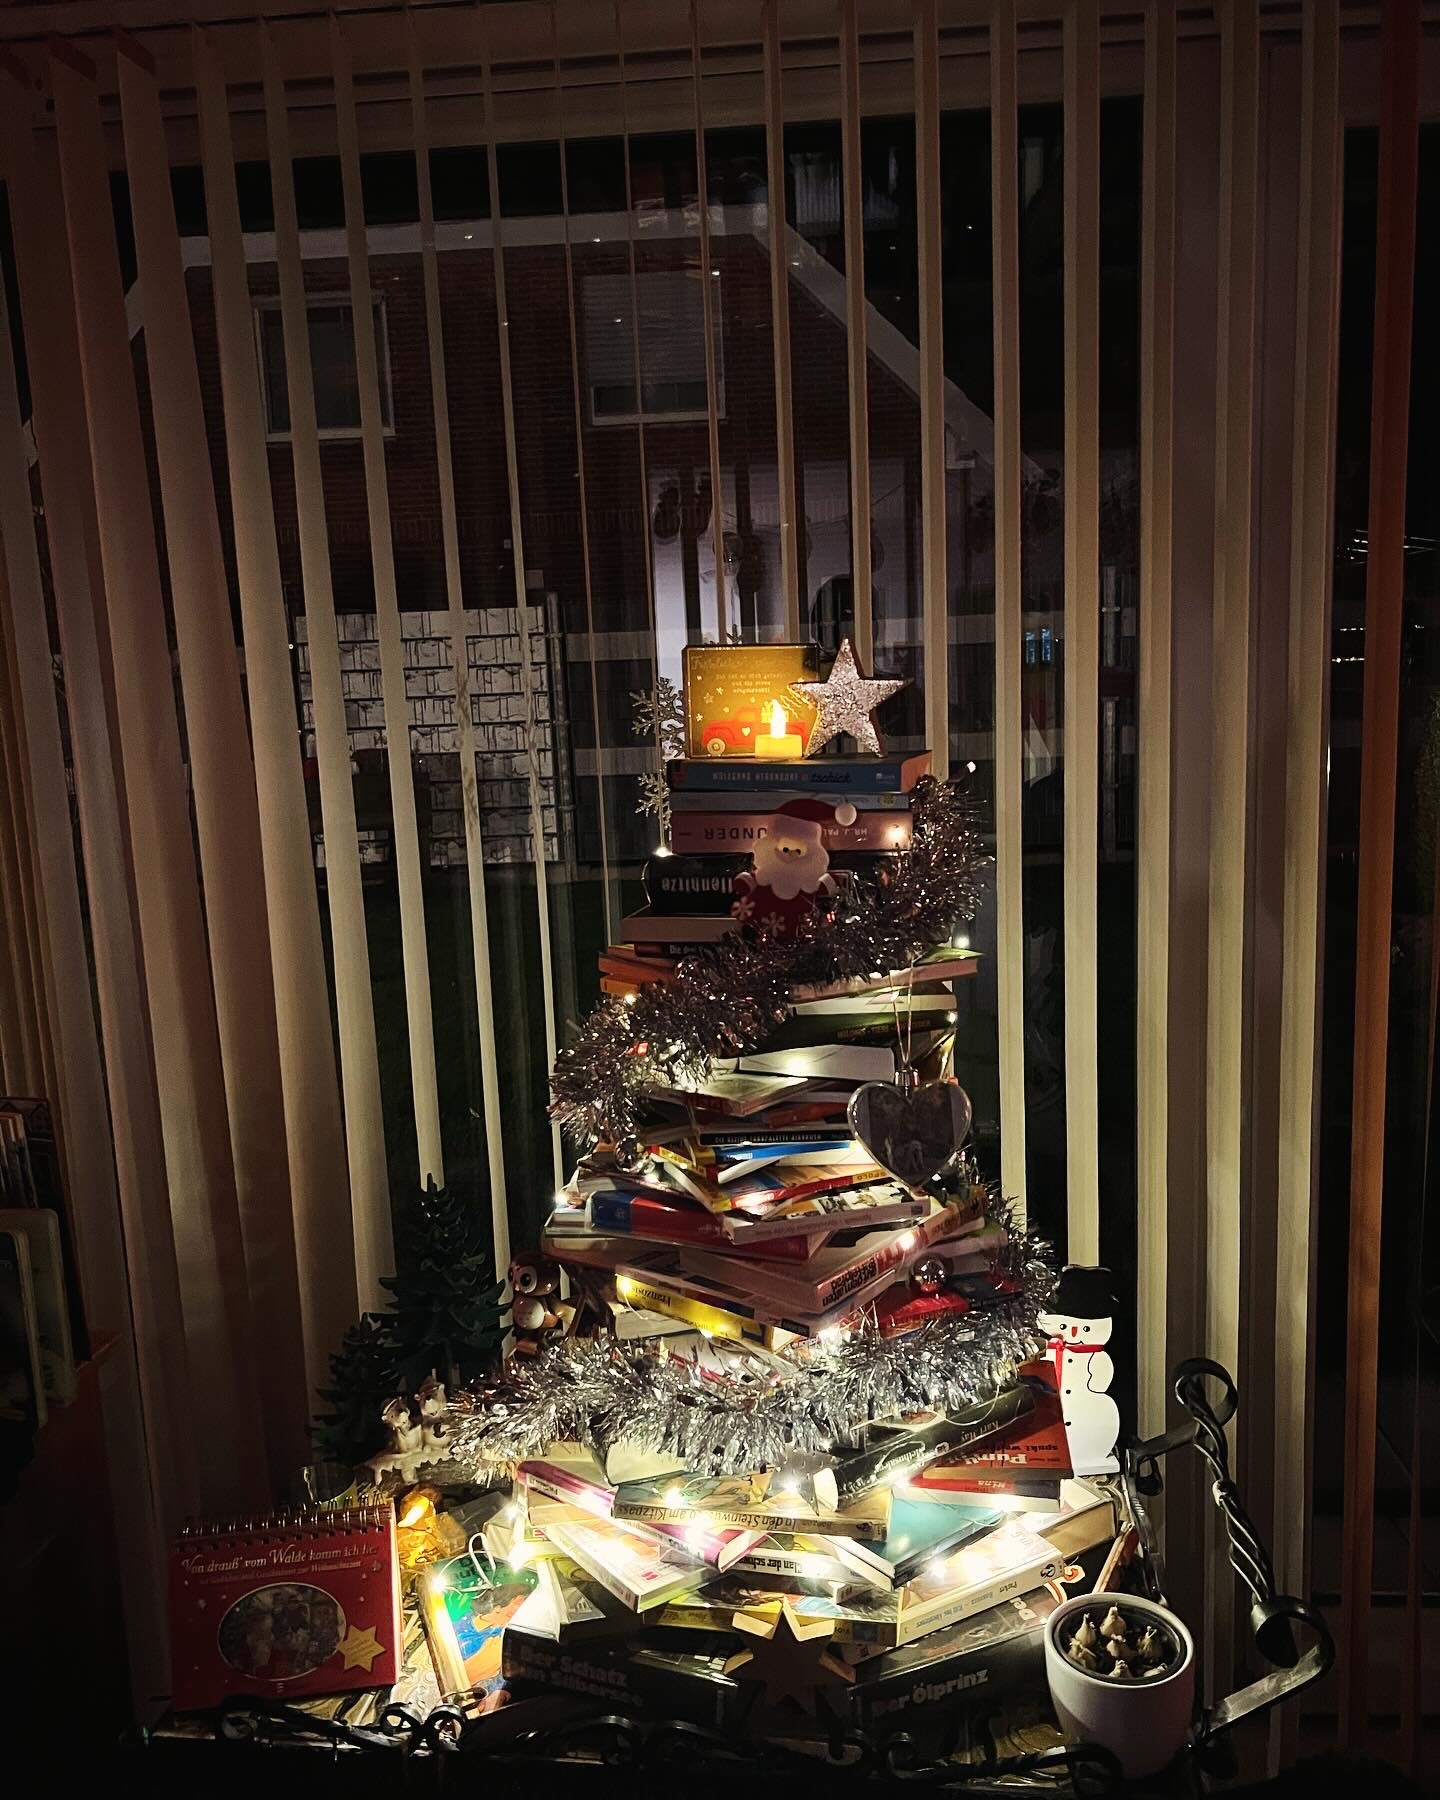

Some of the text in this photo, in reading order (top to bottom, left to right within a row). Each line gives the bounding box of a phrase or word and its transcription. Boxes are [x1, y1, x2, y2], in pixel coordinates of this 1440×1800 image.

[704, 826, 767, 840] UNDER
[661, 873, 734, 894] llenhitze
[783, 1517, 797, 1531] In
[245, 1556, 267, 1568] vom
[269, 1543, 307, 1564] Walde
[309, 1546, 342, 1561] komm
[344, 1545, 359, 1557] ich
[767, 1558, 782, 1571] der
[560, 1655, 626, 1687] Schatz
[911, 1669, 989, 1704] Ölprinz
